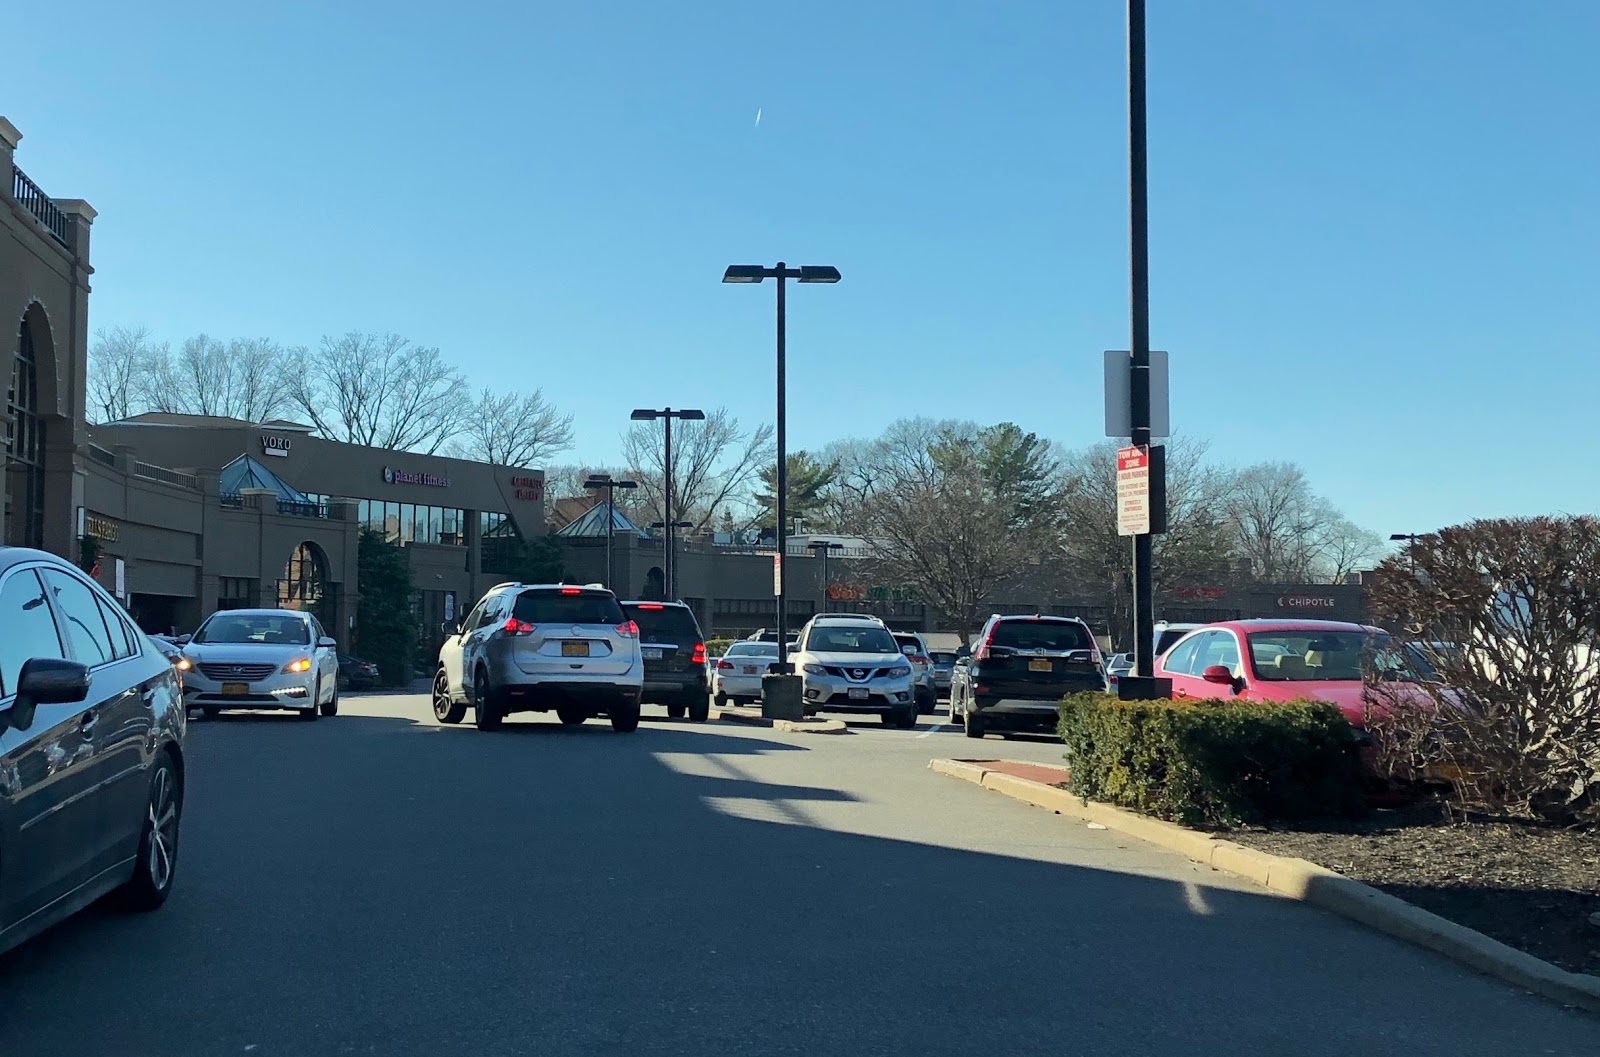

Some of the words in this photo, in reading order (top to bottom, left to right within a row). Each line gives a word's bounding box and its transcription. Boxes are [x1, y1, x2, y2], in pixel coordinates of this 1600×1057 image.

[262, 435, 291, 450] VORO
[1125, 458, 1140, 469] ZONE
[394, 470, 422, 484] planet
[423, 473, 451, 487] fitness
[1288, 598, 1335, 607] CHIPOTLE
